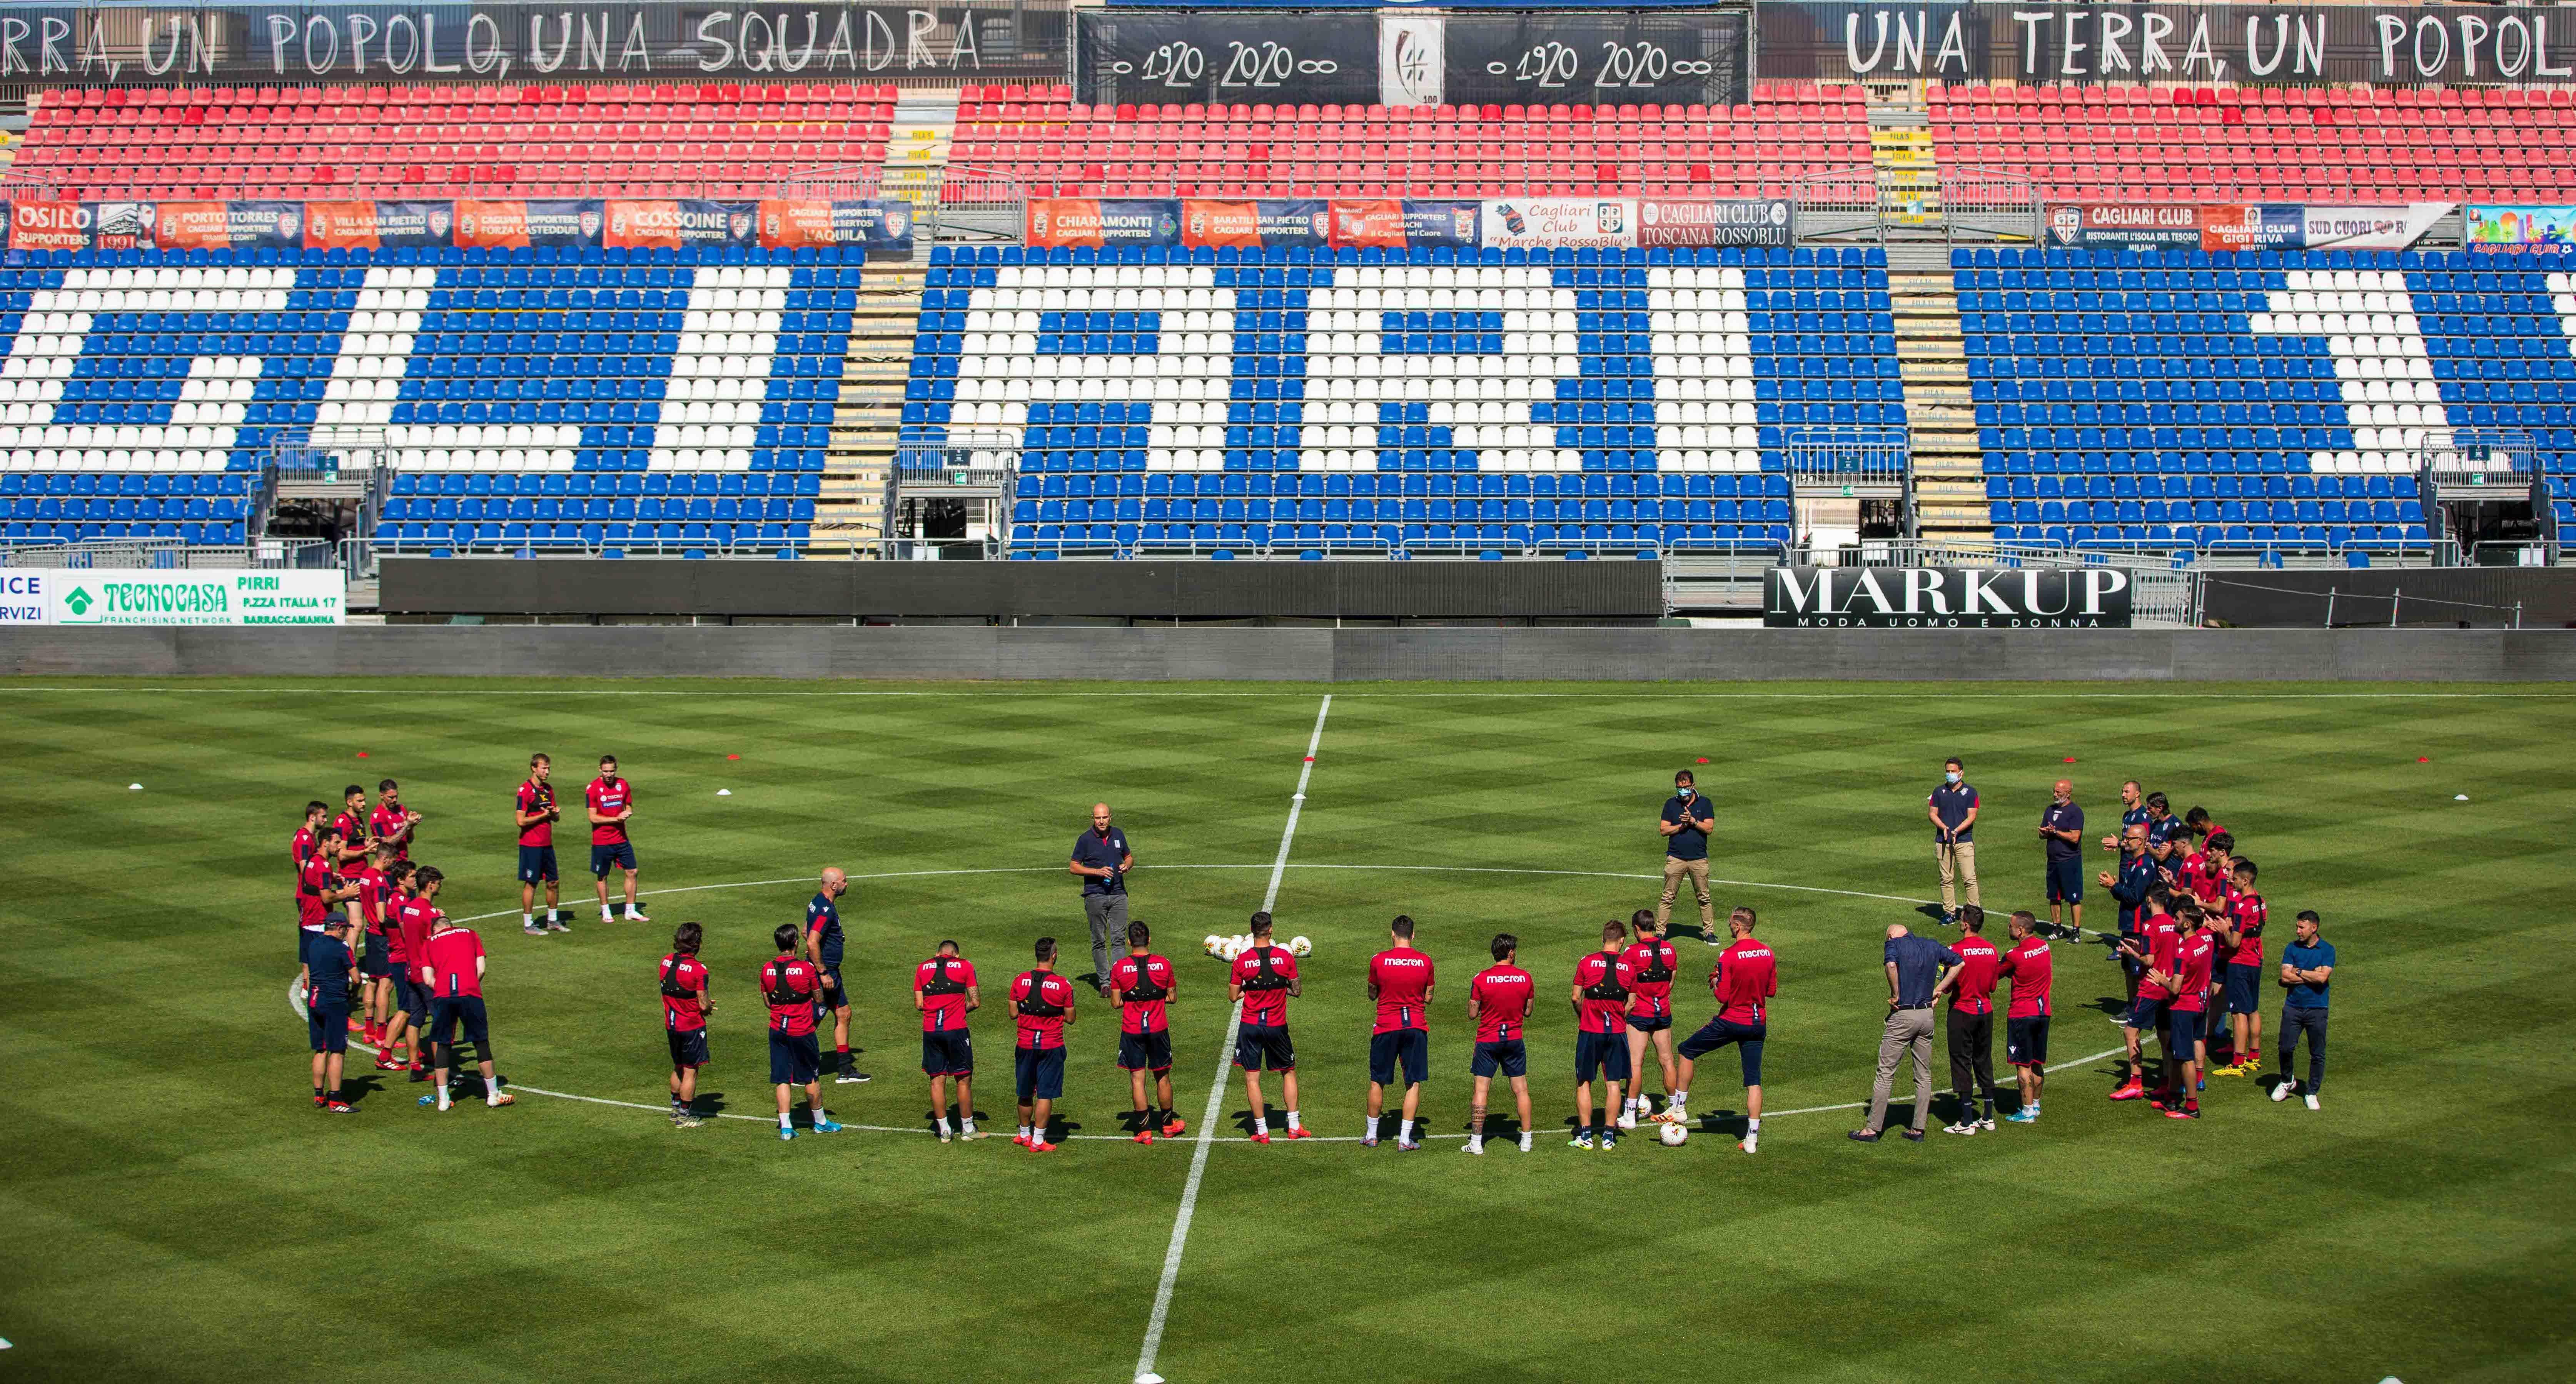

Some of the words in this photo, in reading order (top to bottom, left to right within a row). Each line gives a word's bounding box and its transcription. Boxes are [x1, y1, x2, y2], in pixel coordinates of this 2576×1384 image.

[143, 16, 217, 76] UN
[530, 12, 650, 73] UNA
[698, 10, 980, 72] SQUADRA
[1846, 10, 1967, 73] UNA
[2013, 11, 2226, 82] TERRA,
[2247, 13, 2325, 76] UN
[1142, 41, 1204, 87] 1920
[1221, 41, 1292, 87] 2020
[1516, 42, 1577, 87] 1920
[1594, 42, 1667, 87] 2020
[183, 212, 225, 223] PORTO
[229, 211, 279, 223] TORRES
[788, 209, 829, 217] CAGLIARI
[831, 209, 883, 217] SUPPORTERS
[1529, 204, 1591, 220] Cagliari
[1661, 204, 1728, 224] CAGLIARI
[1731, 204, 1769, 224] CLUB
[2092, 207, 2155, 225] CAGLIARI
[2159, 208, 2193, 225] CLUB
[19, 207, 92, 229] OSILO
[334, 216, 364, 226] VILLA
[366, 216, 386, 226] SAN
[388, 215, 426, 226] PIETRO
[481, 216, 522, 224] CAGLIARI
[524, 215, 579, 224] SUPPORTERS
[635, 212, 727, 229] COSSOINE
[1056, 216, 1152, 227] CHIARAMONTI
[1213, 216, 1254, 224] BARATILI
[1256, 216, 1275, 224] SAN
[1276, 216, 1309, 224] PIETRO
[187, 225, 222, 233] CAGLIARI
[225, 224, 274, 233] SUPPORTERS
[374, 227, 426, 235] SUPPORTERS
[481, 226, 515, 235] FORZA
[1213, 226, 1253, 235] CAGLIARI
[1255, 226, 1309, 235] SUPPORTERS
[1542, 219, 1578, 232] Club
[2209, 225, 2263, 234] CAGLIARI
[2266, 225, 2297, 234] CLUB
[2309, 220, 2332, 234] SUD
[2334, 220, 2372, 235] CUORI
[17, 232, 90, 246] SUPPORTERS
[634, 229, 674, 237] CAGLIARI
[676, 229, 727, 239] SUPPORTERS
[803, 229, 867, 241] L'AQUILA
[1056, 229, 1096, 237] CAGLIARI
[1098, 229, 1152, 238] SUPPORTERS
[1377, 230, 1405, 238] Cagliari
[1642, 227, 1709, 245] TOSCANA
[1713, 227, 1787, 245] ROSSOBLU
[2086, 231, 2129, 241] RISTORANTE
[2129, 231, 2156, 241] L'ISOLA
[2157, 232, 2170, 241] DEL
[2171, 232, 2199, 241] TESORO
[2222, 234, 2249, 244] GIGI
[2253, 234, 2284, 244] RIVA
[99, 236, 135, 249] 1991
[2128, 244, 2157, 252] MILANO
[2473, 244, 2528, 255] CAGLIARI
[2529, 244, 2559, 255] CLUB
[0, 577, 40, 594] ICE
[238, 577, 280, 590] PIRRI
[1770, 568, 2127, 615] MARKUP
[104, 583, 227, 612] TECNOCASA
[243, 597, 276, 607] P.ZZA
[279, 597, 319, 607] ITALIA
[323, 597, 337, 607] 17
[243, 615, 335, 624] BARRACCAMANNA
[1798, 617, 1867, 628] MODA
[1888, 617, 1959, 628] UOMO
[1981, 618, 1989, 628] E
[2012, 617, 2099, 628] DONNA
[430, 928, 470, 941] macron
[1639, 947, 1672, 958] maron
[1737, 948, 1771, 959] macron
[1963, 948, 1995, 956] macron
[662, 959, 692, 973] maon
[922, 961, 961, 971] maon
[1123, 963, 1164, 973] maron
[1245, 957, 1283, 969] maon
[1384, 958, 1424, 967] macron
[1591, 959, 1628, 972] maon
[766, 967, 802, 976] mron
[1022, 978, 1060, 990] mron
[1487, 975, 1526, 983] macron
